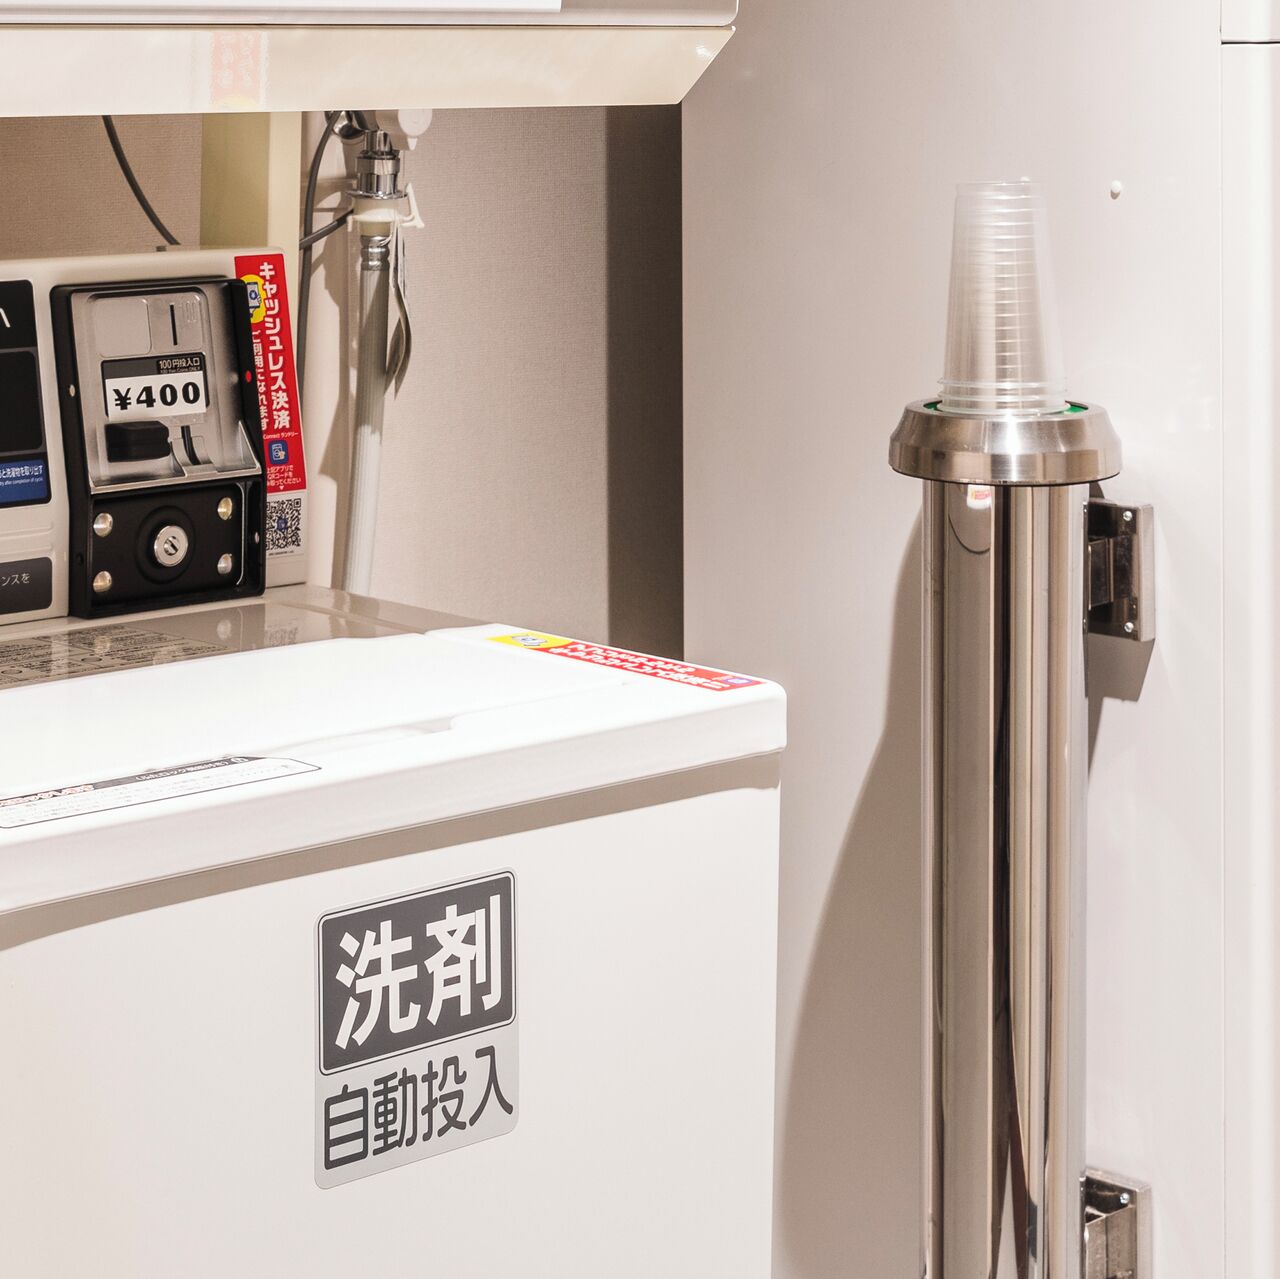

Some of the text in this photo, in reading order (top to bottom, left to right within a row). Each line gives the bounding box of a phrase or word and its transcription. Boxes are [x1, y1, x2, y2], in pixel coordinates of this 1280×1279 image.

[113, 382, 200, 410] ¥400
[159, 358, 200, 369] 100円投入口
[259, 261, 291, 430] キャッシュレス決済
[335, 894, 502, 1050] 洗剤
[324, 1045, 514, 1171] 自動投入
